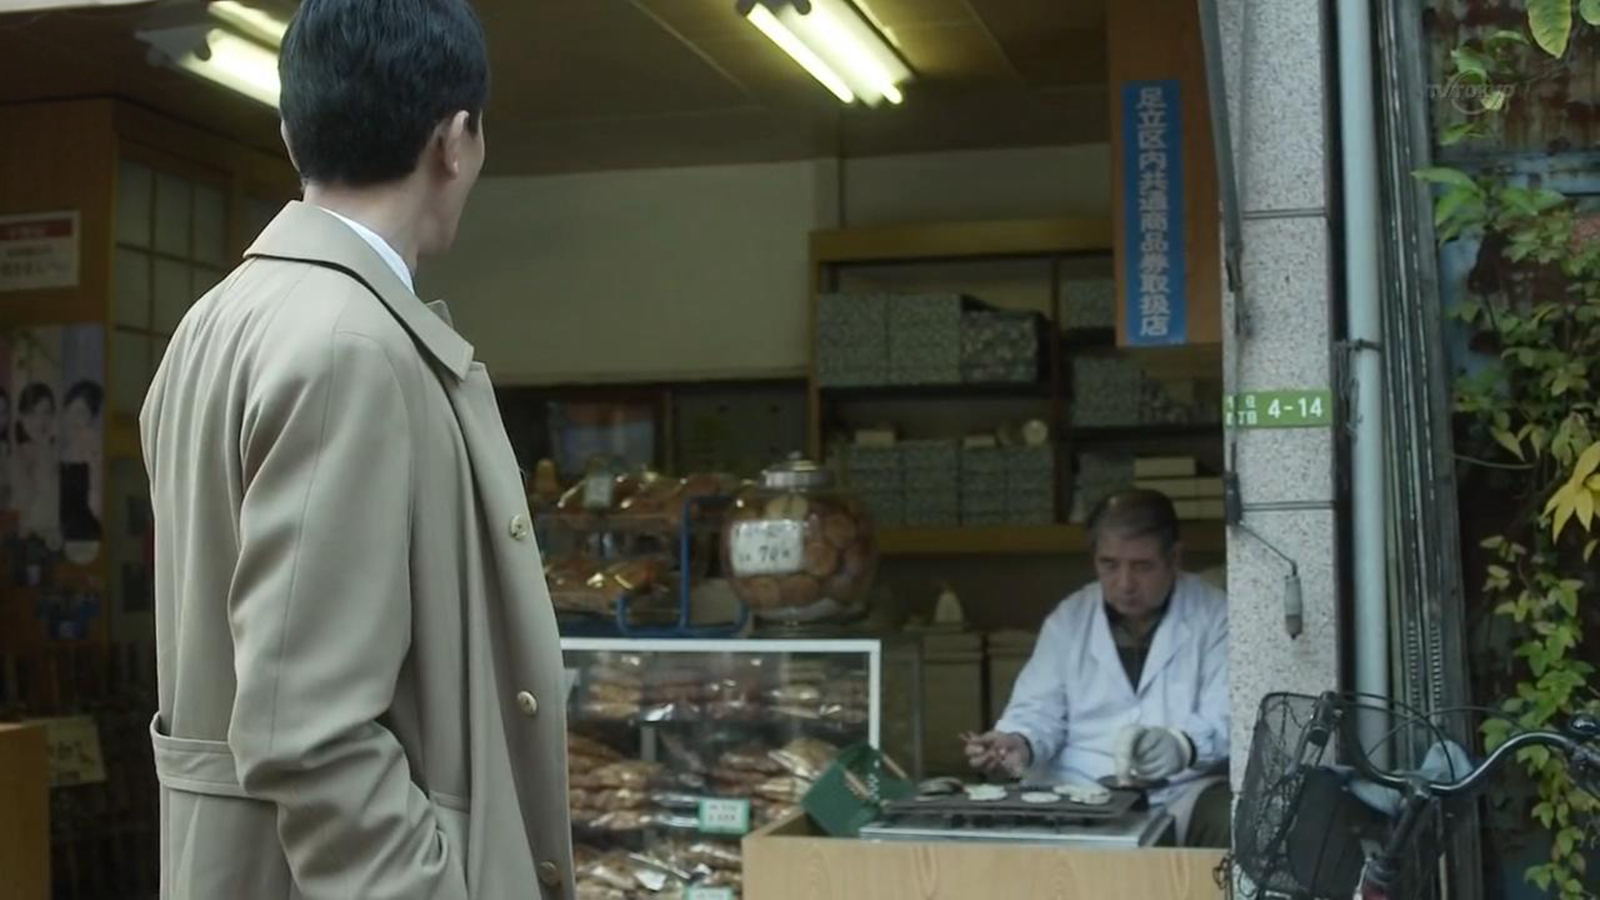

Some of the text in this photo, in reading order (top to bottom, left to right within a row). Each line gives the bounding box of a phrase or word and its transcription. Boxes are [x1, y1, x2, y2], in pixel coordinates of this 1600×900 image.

[1136, 86, 1170, 337] 足立区内共通商品券取扱店
[1268, 396, 1323, 419] 4-14
